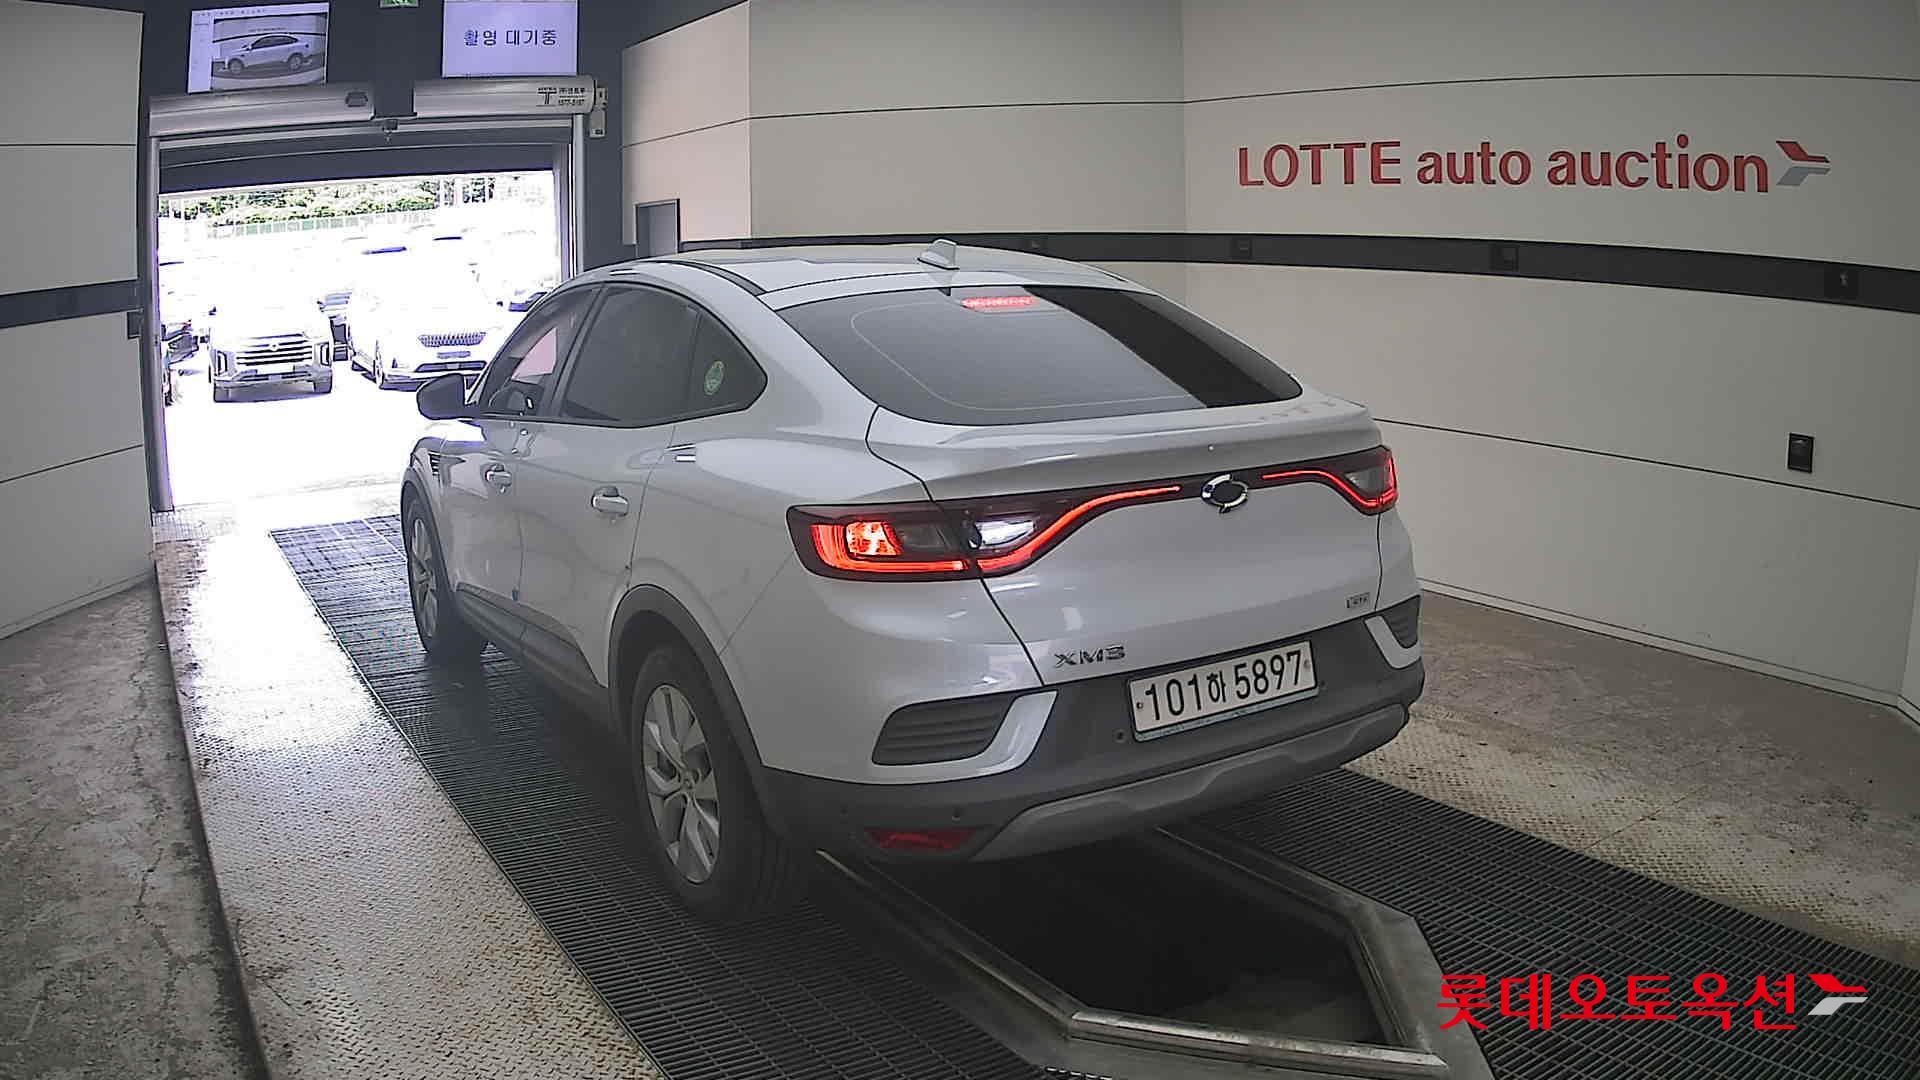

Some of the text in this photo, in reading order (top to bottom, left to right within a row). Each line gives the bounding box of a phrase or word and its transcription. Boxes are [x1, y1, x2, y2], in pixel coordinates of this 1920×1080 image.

[505, 29, 557, 46] 대기중
[1239, 134, 1768, 193] LOTTE auto auction
[1054, 643, 1125, 668] XM3
